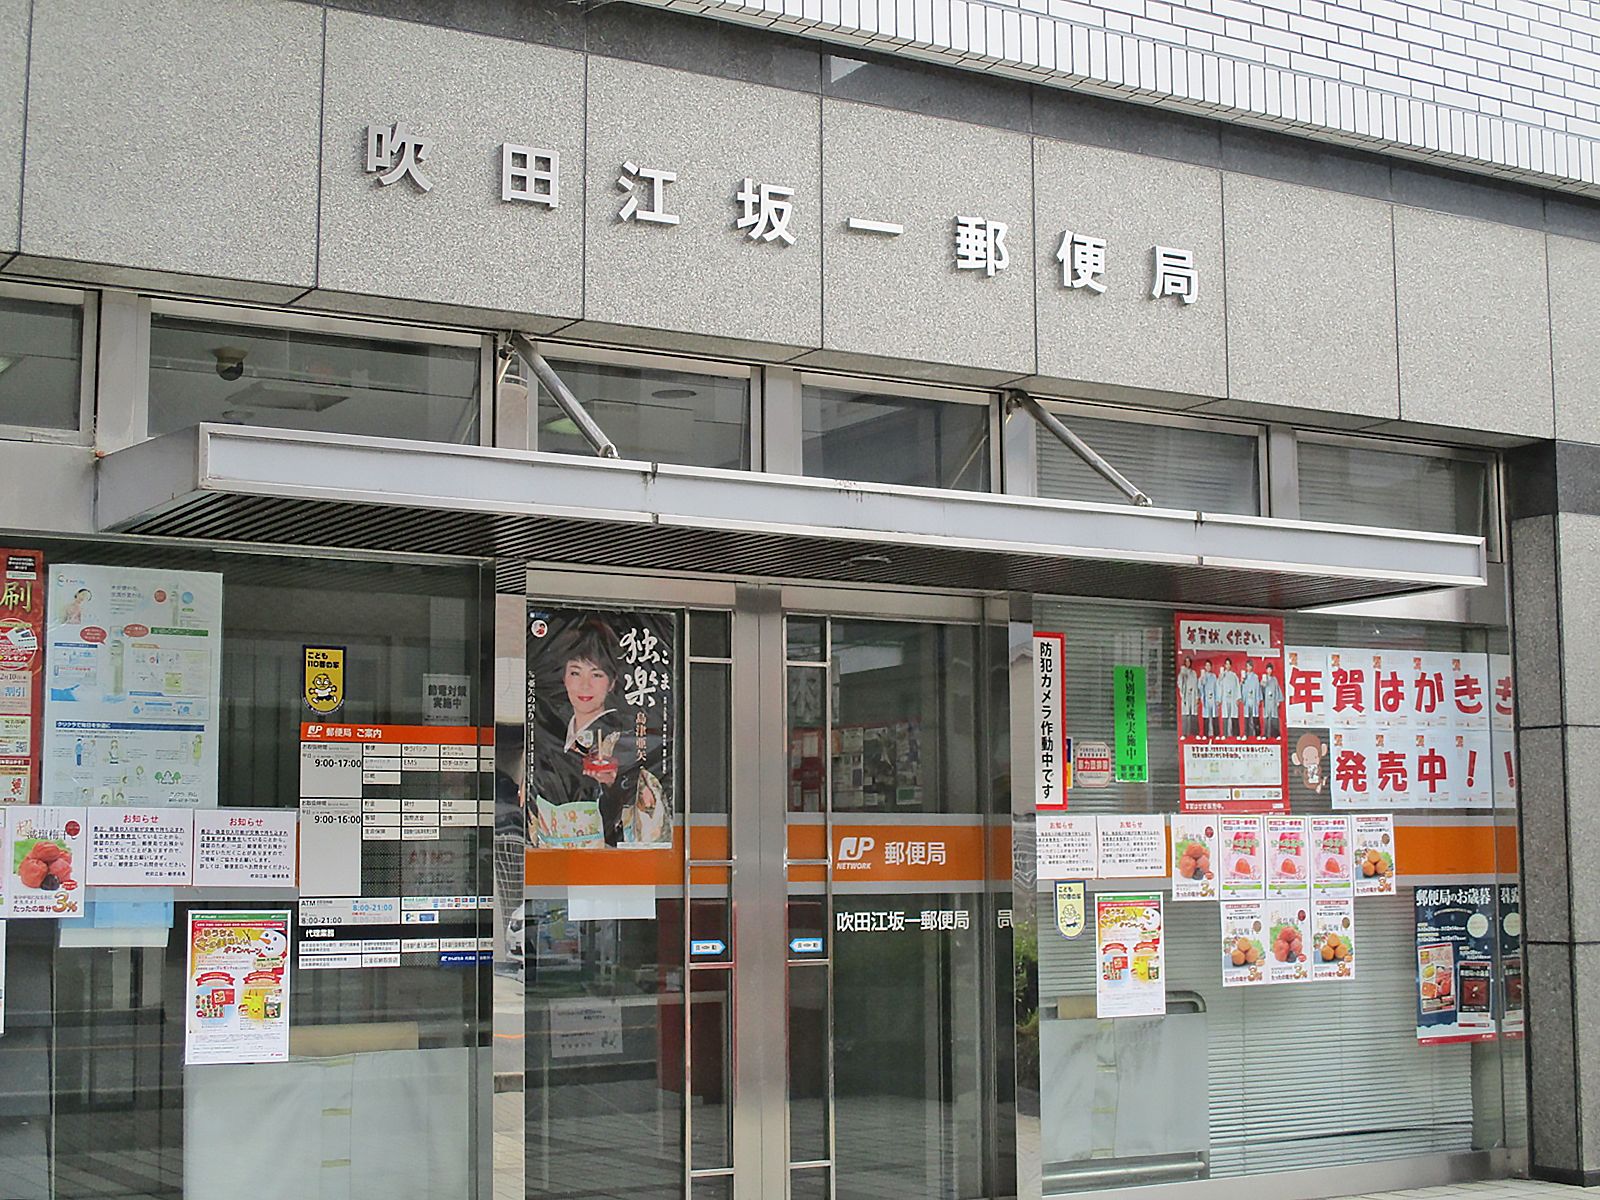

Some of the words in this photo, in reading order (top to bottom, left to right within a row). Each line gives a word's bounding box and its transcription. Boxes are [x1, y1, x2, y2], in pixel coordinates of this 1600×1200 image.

[366, 121, 1199, 305] 吹田江坂一郵便局
[1186, 626, 1265, 645] 年賀状、ください。
[617, 627, 660, 707] 独楽
[1289, 667, 1482, 714] 年賀はがき
[1040, 642, 1054, 799] 防犯カメラ作動中です
[326, 728, 352, 738] 郵便局
[356, 728, 382, 738] ご案内
[314, 759, 361, 768] 9:00-17:00
[1336, 748, 1477, 794] 発売中！
[123, 814, 159, 824] お知らせ
[229, 818, 264, 826] お知らせ
[314, 816, 360, 824] 9:00-16:00
[884, 842, 946, 865] 郵便局
[1416, 888, 1491, 906] 郵便局のお歳暮
[836, 911, 970, 932] 吹田江坂一郵便局
